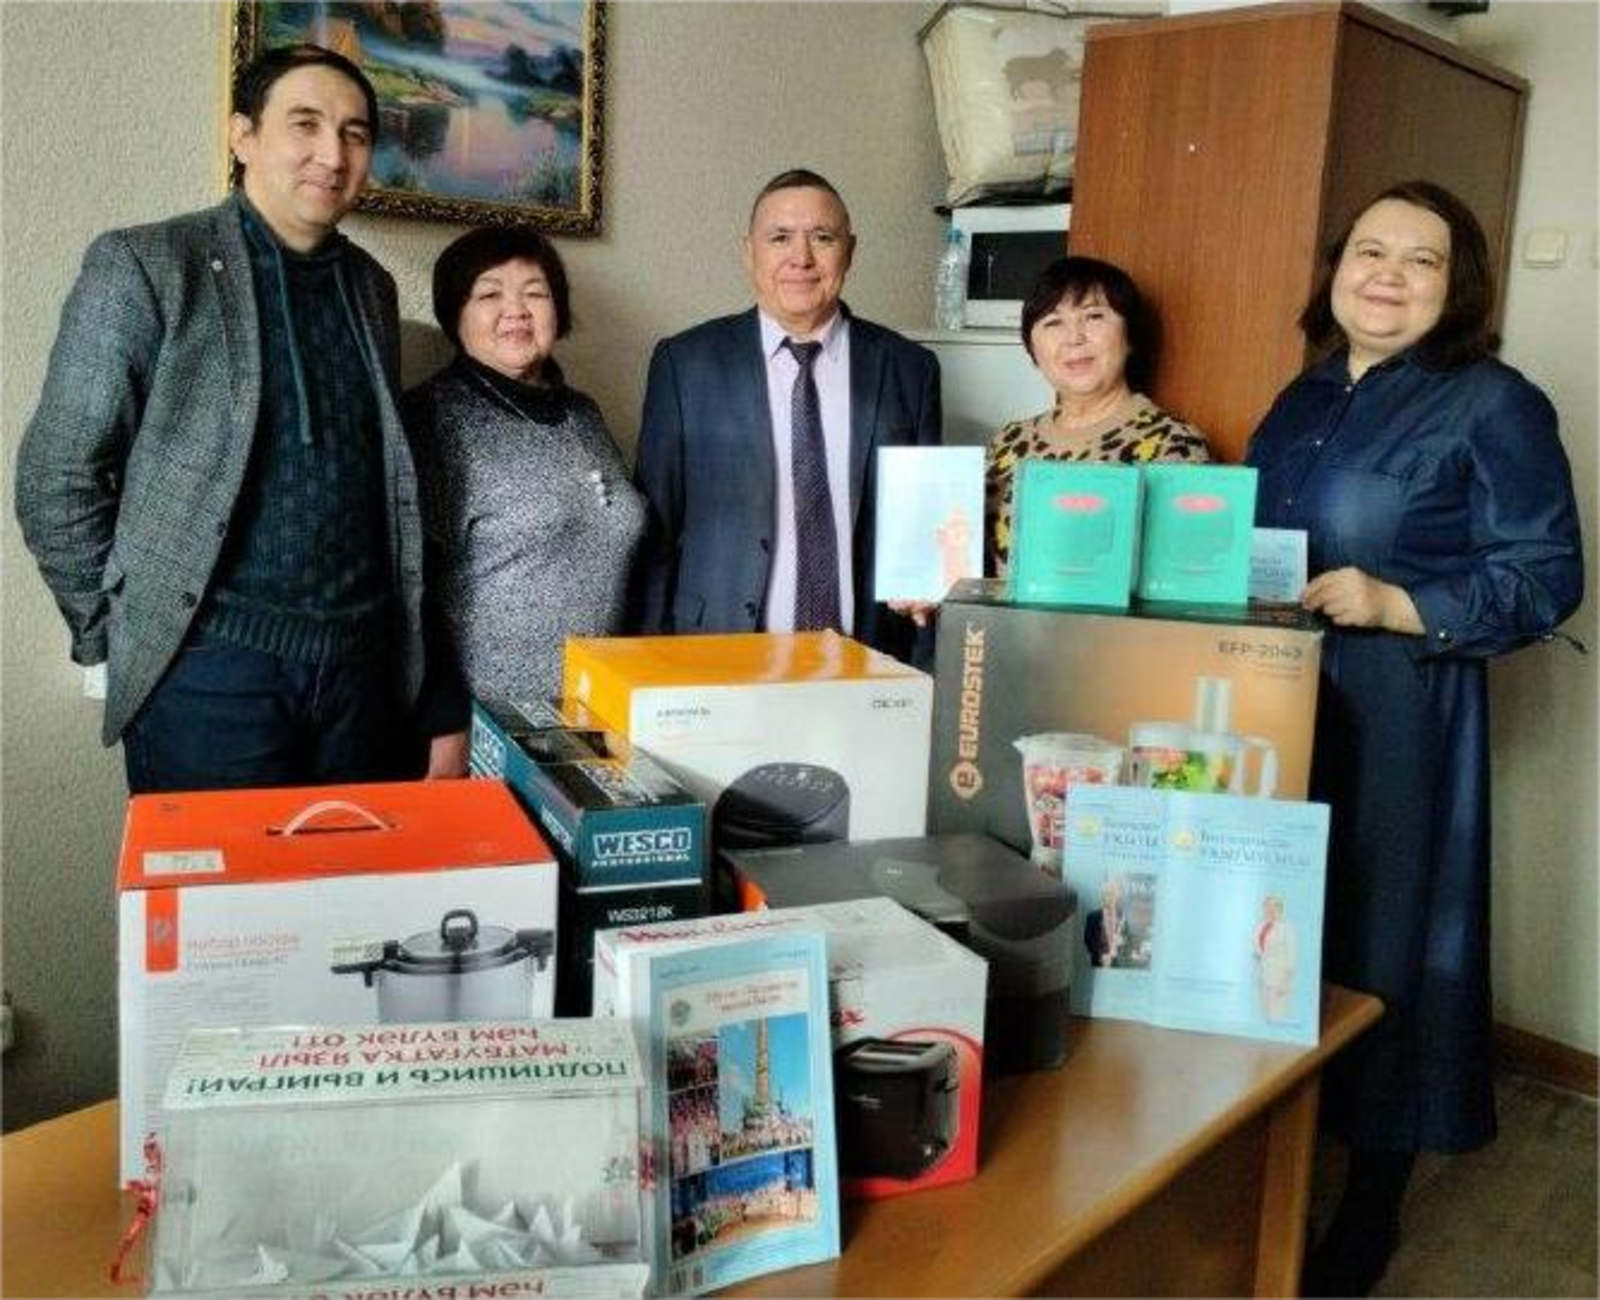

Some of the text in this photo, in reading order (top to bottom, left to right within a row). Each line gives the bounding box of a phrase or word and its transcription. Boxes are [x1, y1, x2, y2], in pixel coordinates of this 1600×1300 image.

[958, 621, 985, 759] EUROSTEK
[593, 827, 691, 859] WESCO
[186, 1061, 627, 1095] ПОДПИШИСЬ И ВЫИГРАЙ!
